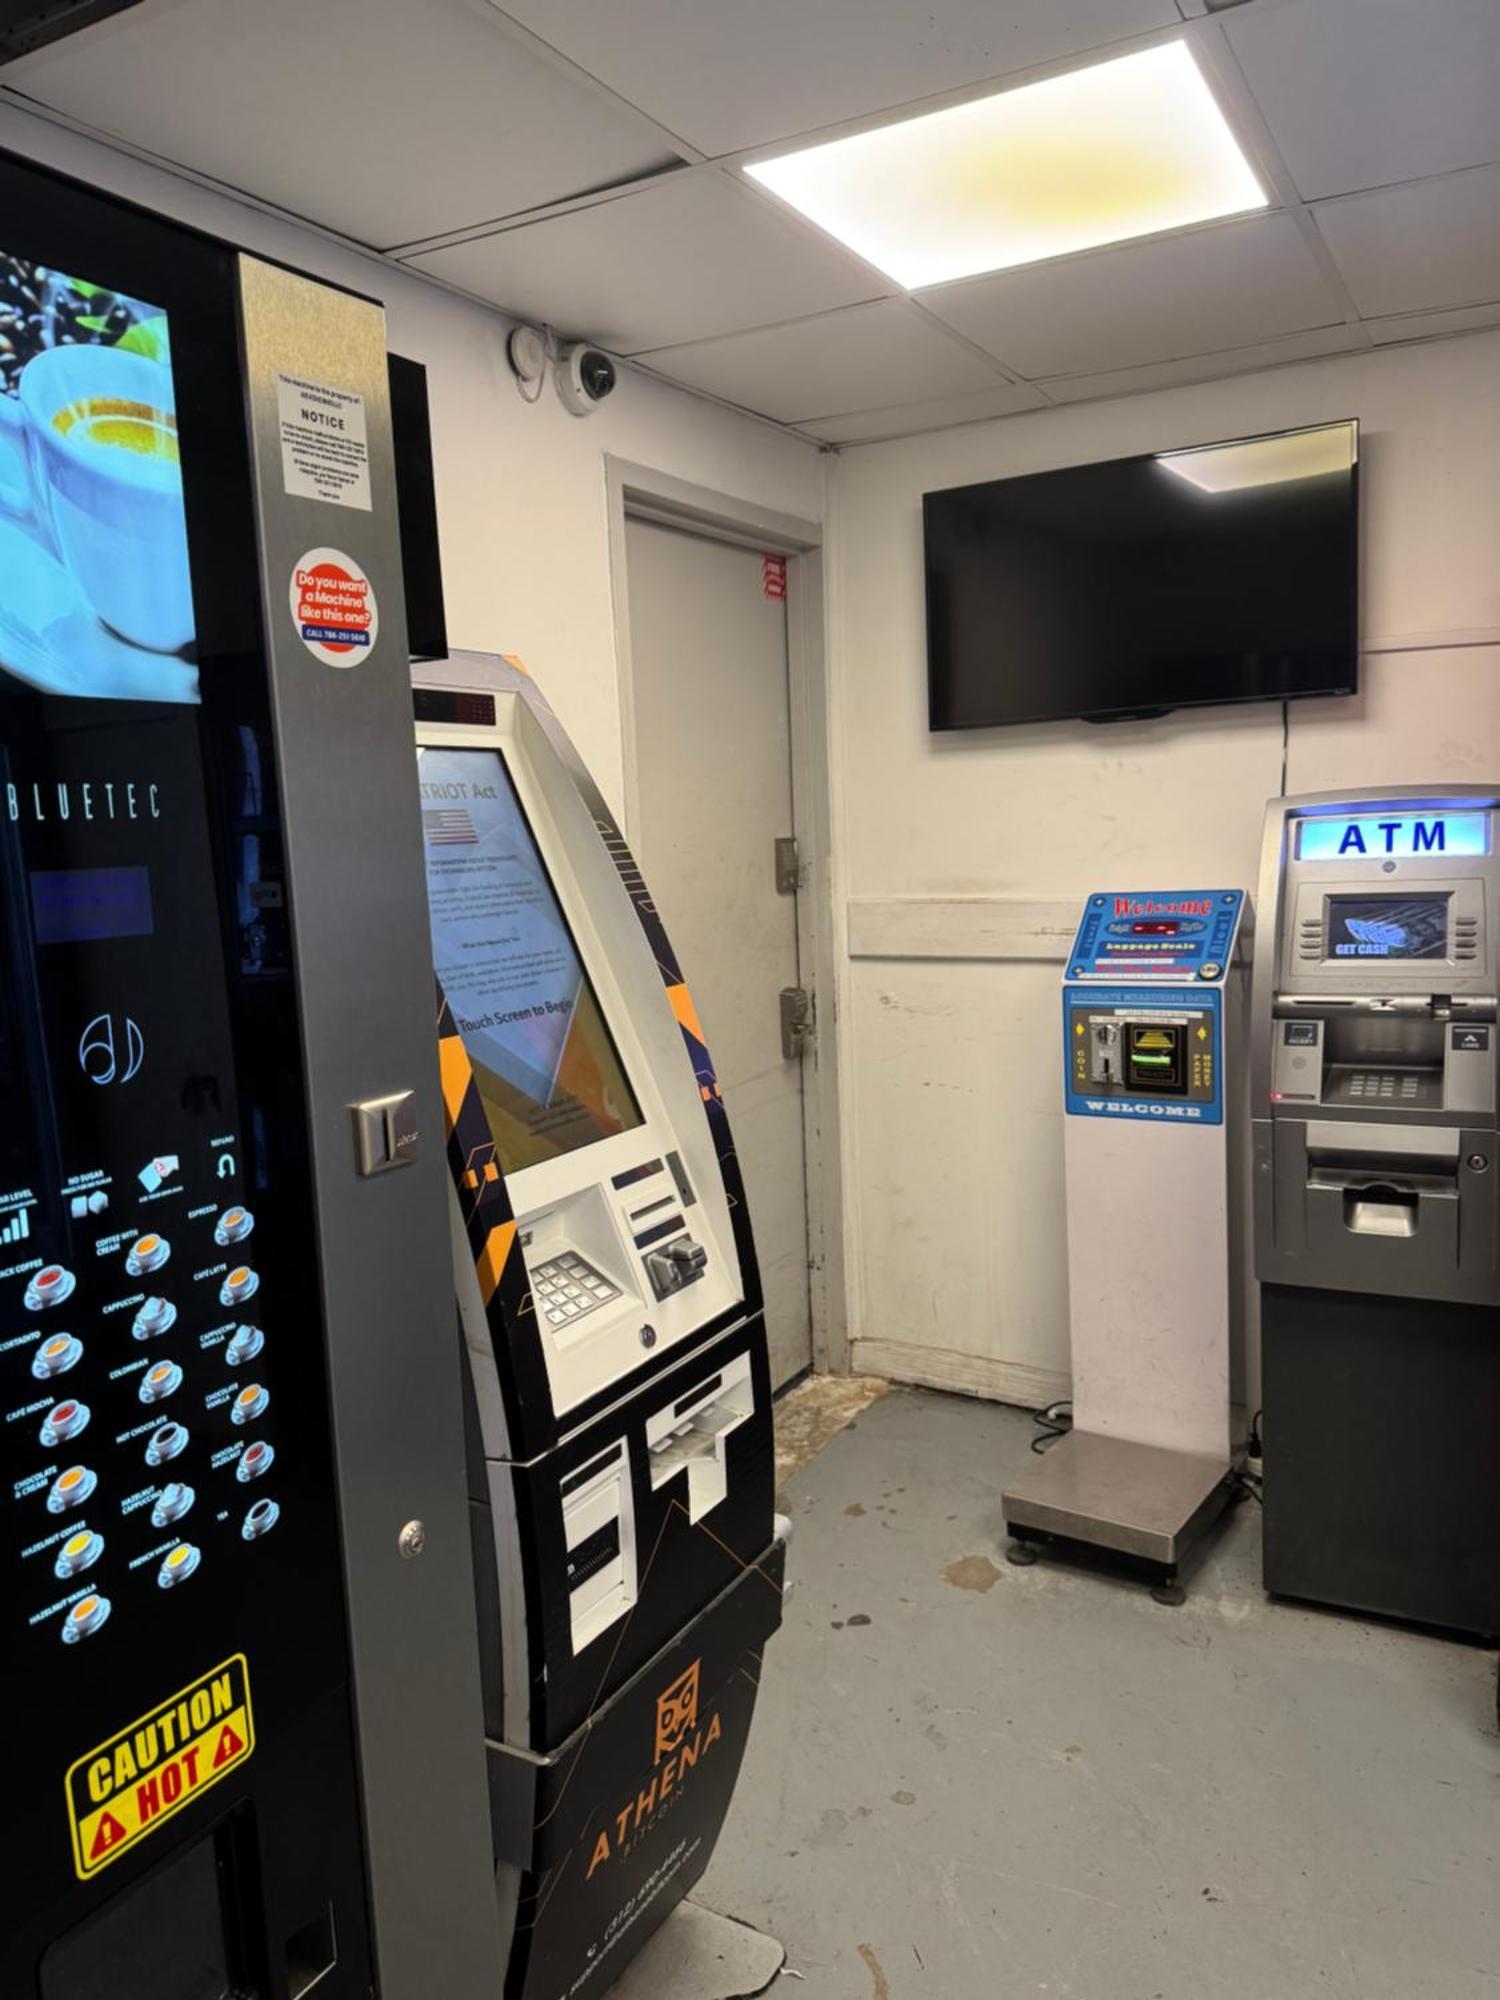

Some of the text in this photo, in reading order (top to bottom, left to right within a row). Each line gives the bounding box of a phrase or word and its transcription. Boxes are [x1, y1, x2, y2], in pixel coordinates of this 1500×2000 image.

[301, 408, 344, 431] NOTICE
[299, 572, 366, 593] Do you want
[305, 590, 362, 608] a Machine
[300, 604, 370, 625] like this one?
[6, 783, 160, 821] BLUETEC
[474, 784, 499, 800] Act
[1338, 820, 1446, 854] ATM
[1113, 896, 1213, 918] Welcome
[1106, 942, 1196, 952] Luggage Scale
[1335, 943, 1389, 955] GET CASH
[458, 996, 574, 1032] Touch Screen to Begin
[1085, 1100, 1201, 1118] WELCOME
[10, 1188, 33, 1202] LEVEL
[188, 1203, 218, 1219] ESPRESSO
[96, 1235, 121, 1248] COFFEE
[15, 1258, 43, 1273] COFFEE
[209, 1263, 228, 1276] LATTE
[102, 1293, 145, 1314] CAPPUCCINO
[199, 1322, 237, 1342] CAPPUCCINO
[205, 1382, 239, 1402] CHOCOLATE
[26, 1396, 55, 1414] MOCHA
[116, 1415, 168, 1444] HOT CHOCOLATE
[211, 1440, 244, 1461] CHOCOLATE
[14, 1465, 57, 1490] CHOCOLATE
[22, 1477, 49, 1495] CREAM
[122, 1489, 163, 1515] CAPPUCCINO
[216, 1510, 229, 1521] TEA
[21, 1519, 86, 1558] HAZELNUT COFFEE
[129, 1537, 181, 1570] FRENCH VANILLA
[29, 1583, 97, 1625] HAZELNUT VANILLA
[87, 1672, 233, 1803] CAUTION
[136, 1746, 200, 1825] HOT
[586, 1712, 721, 1880] ATHENA
